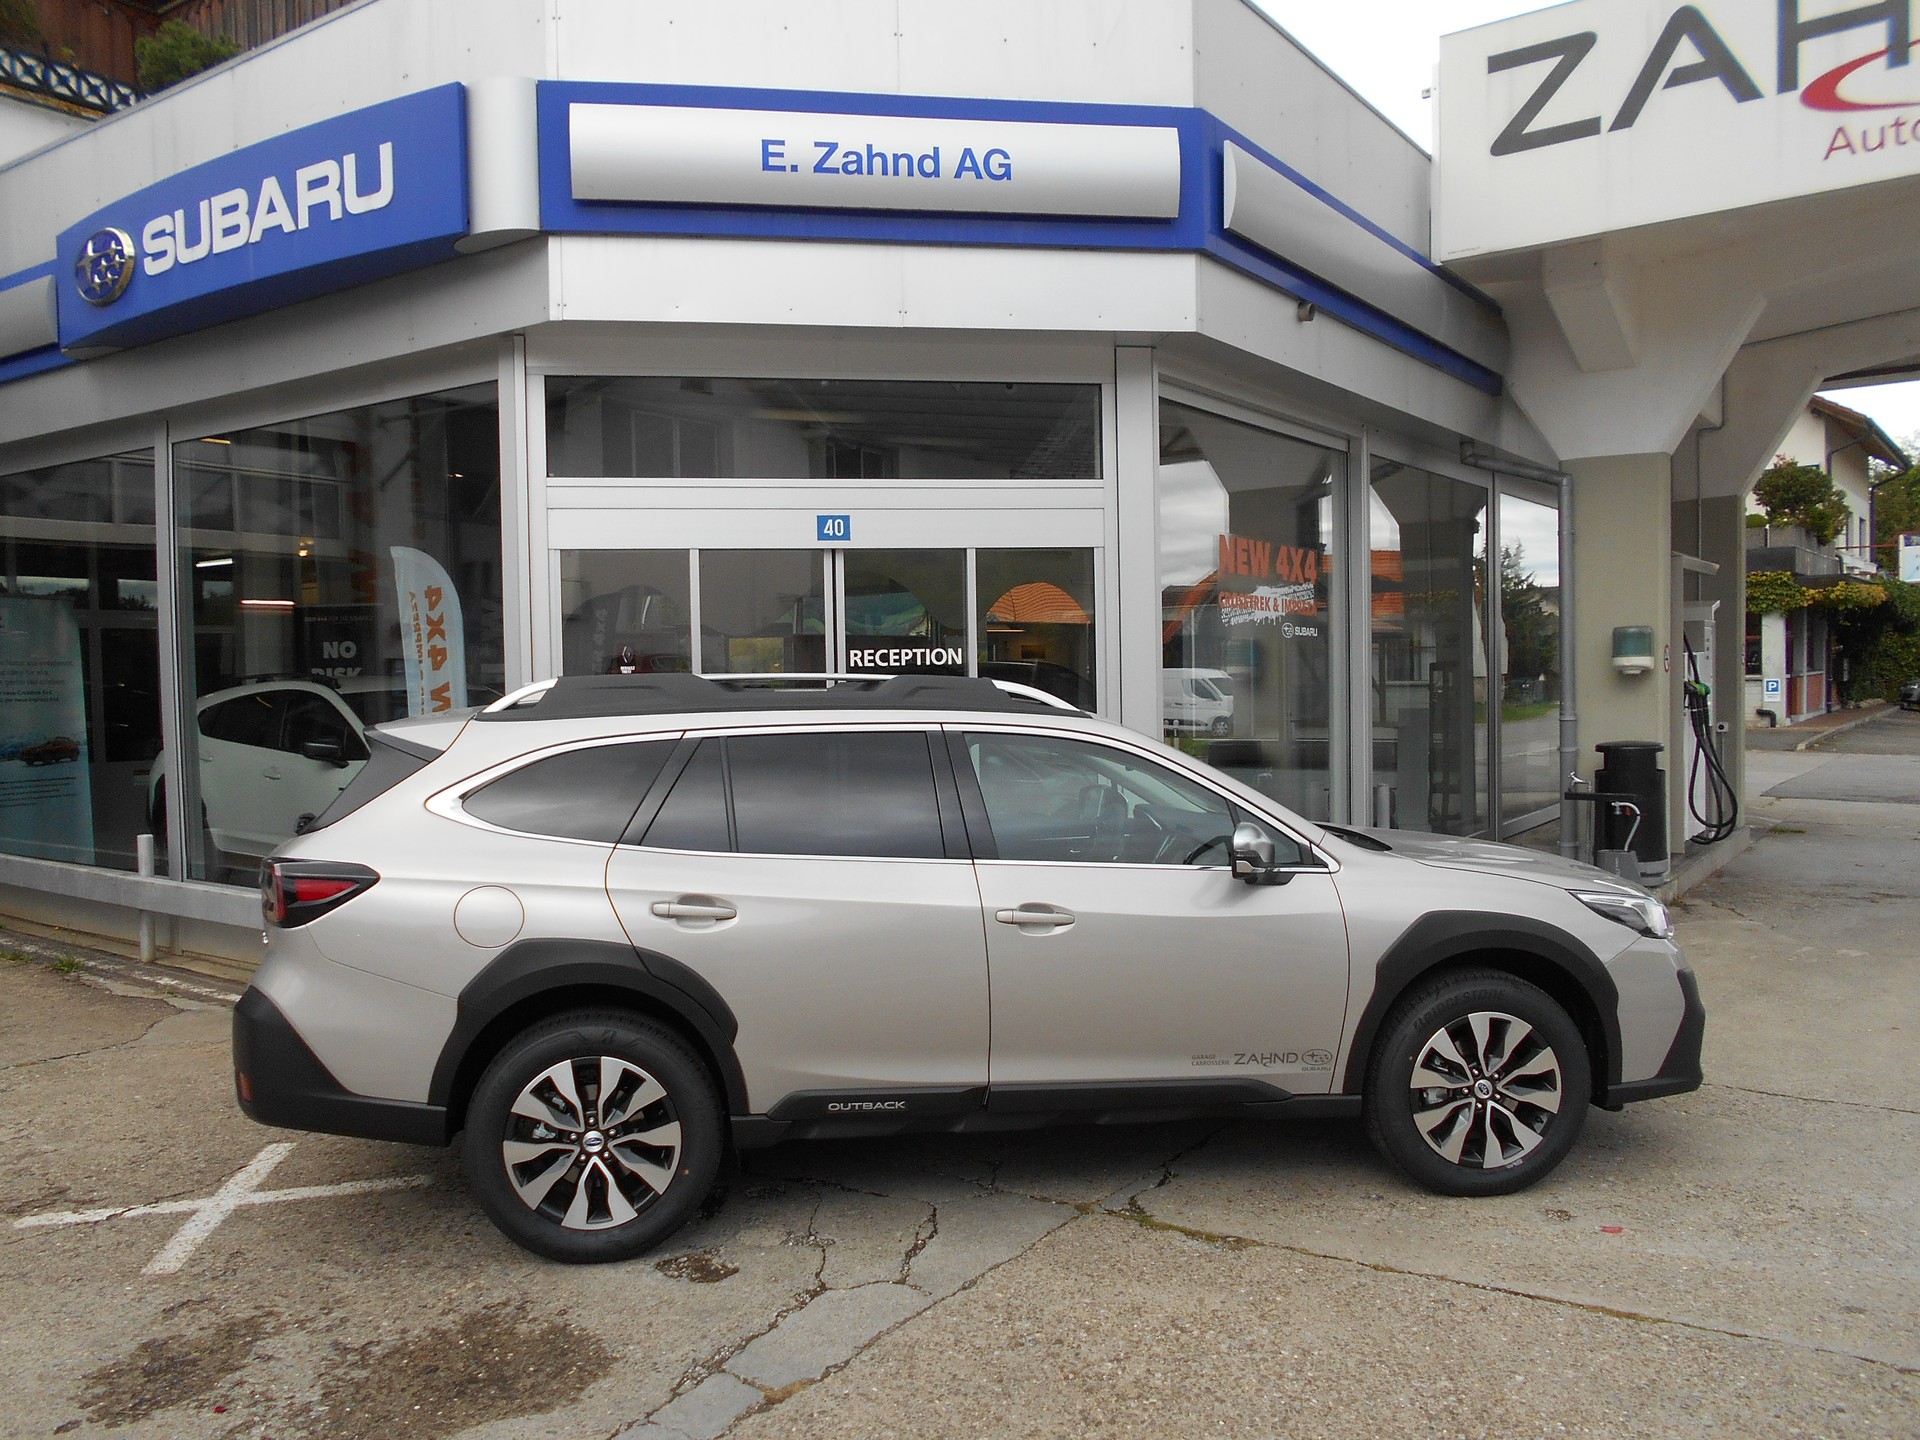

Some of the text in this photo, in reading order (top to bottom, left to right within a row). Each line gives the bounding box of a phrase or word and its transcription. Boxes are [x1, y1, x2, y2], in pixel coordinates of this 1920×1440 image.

[761, 139, 1012, 181] E. Zahnd AG
[142, 141, 394, 276] SUBARU
[823, 518, 844, 536] 40
[1219, 534, 1317, 585] NEW 4X4
[1294, 626, 1317, 636] SUBARU
[323, 641, 357, 659] NO
[850, 648, 962, 667] RECEPTION
[1234, 1052, 1299, 1067] ZAHND
[828, 1101, 906, 1111] OUTBACK
